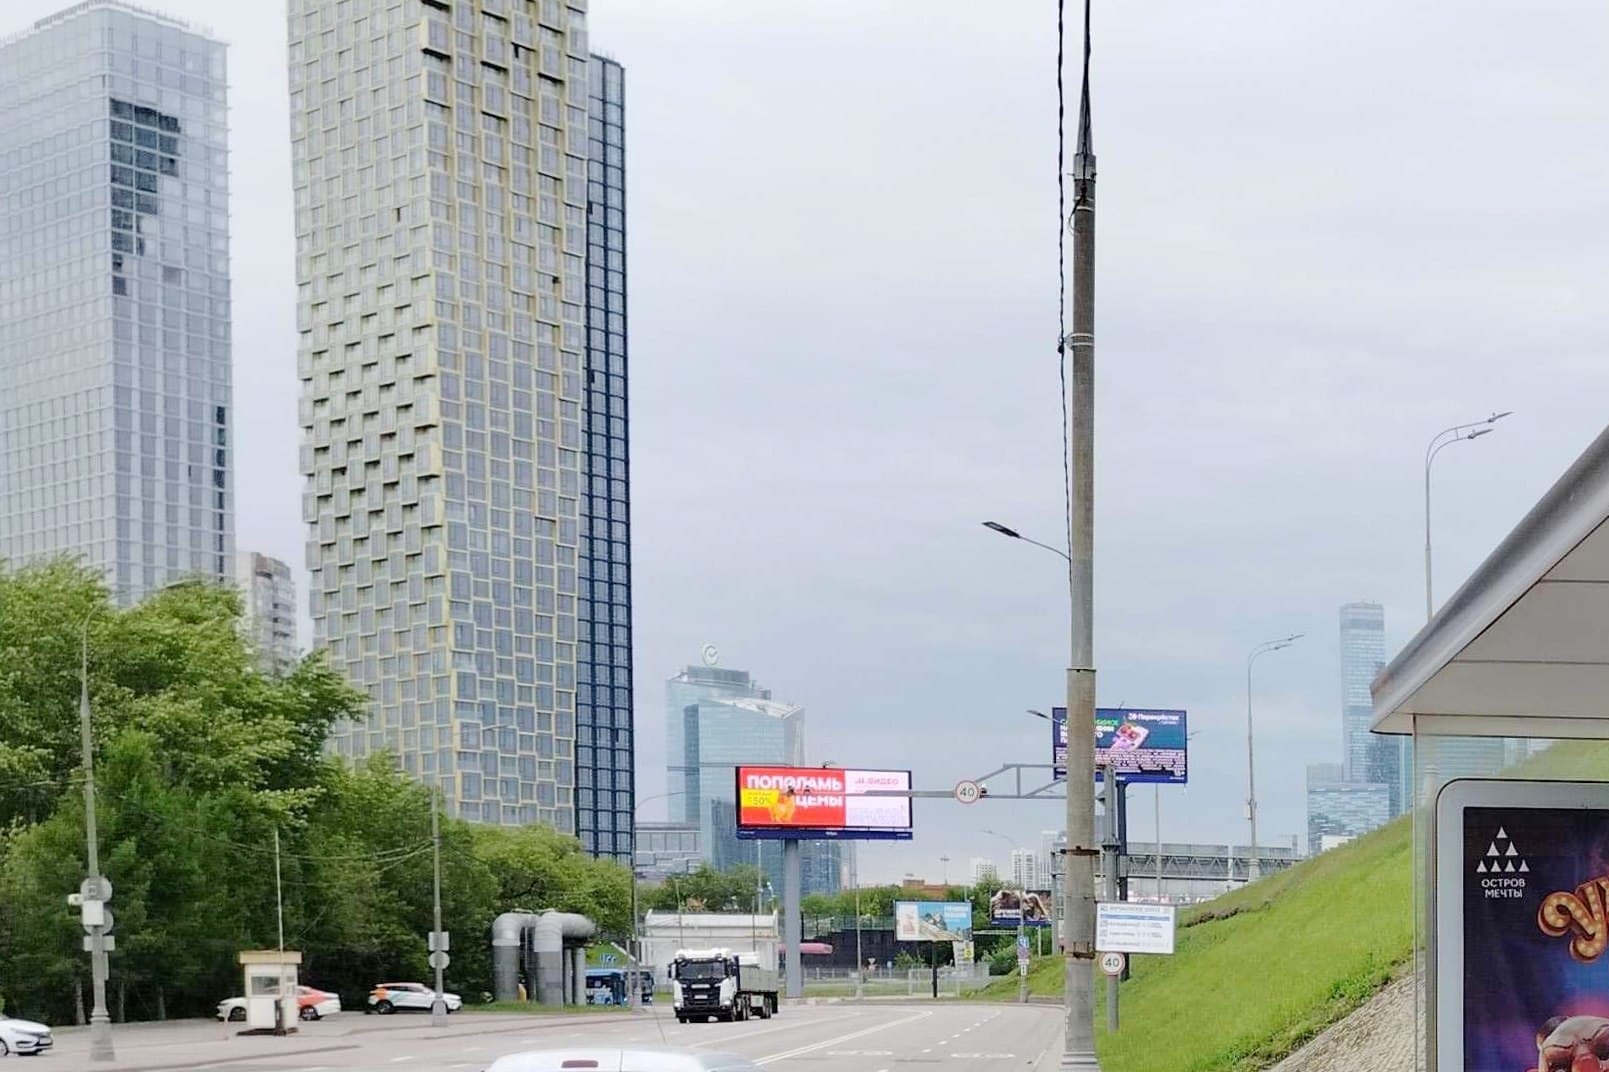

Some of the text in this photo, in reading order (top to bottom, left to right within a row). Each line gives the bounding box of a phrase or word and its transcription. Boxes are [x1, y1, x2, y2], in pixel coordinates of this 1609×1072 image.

[747, 775, 842, 790] ПОПОЛАМЬ
[960, 787, 975, 797] 40
[795, 795, 842, 808] ЦЕНЫ
[1481, 878, 1526, 889] ОСТРОВ
[1484, 889, 1523, 898] МЕЧТЫ
[1104, 958, 1120, 967] 40
